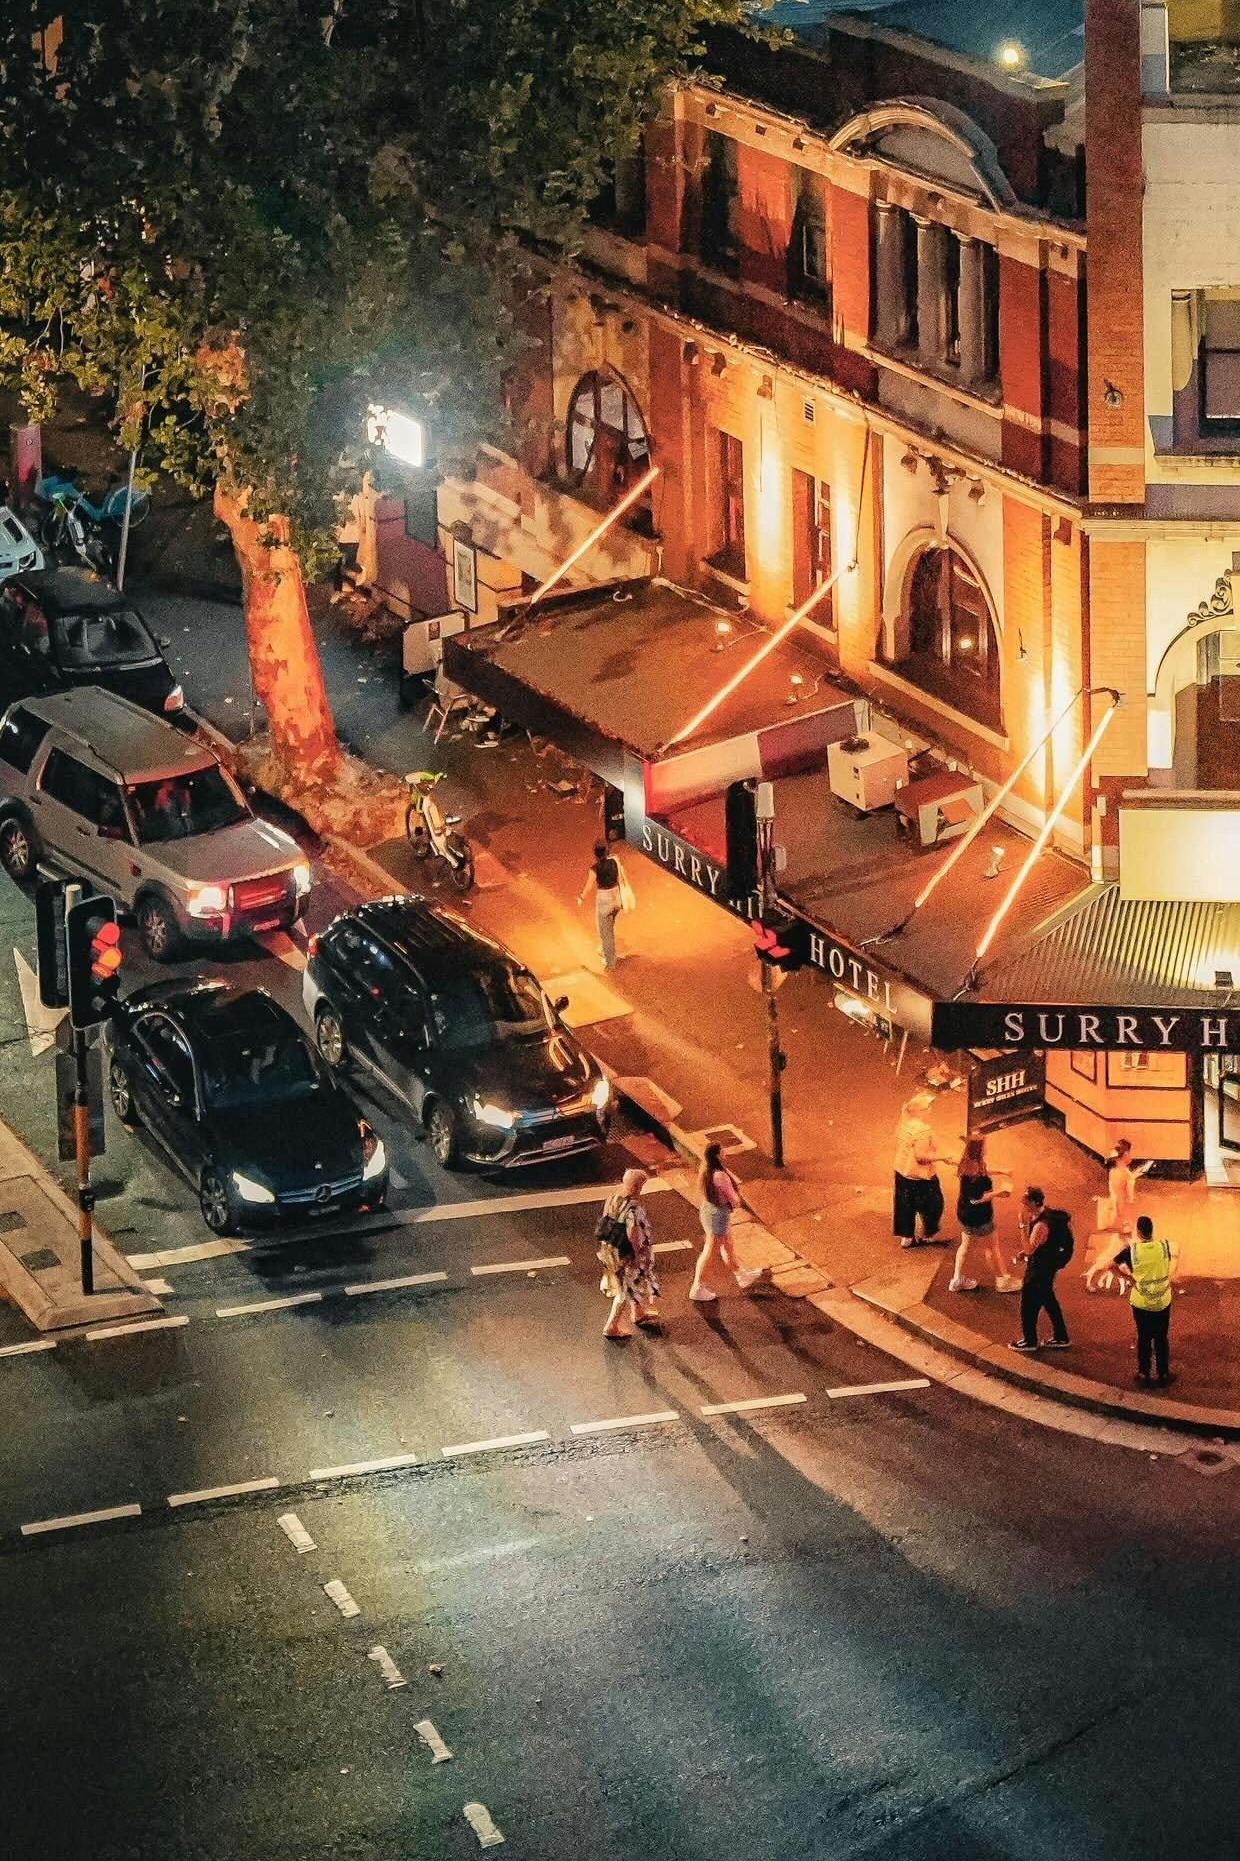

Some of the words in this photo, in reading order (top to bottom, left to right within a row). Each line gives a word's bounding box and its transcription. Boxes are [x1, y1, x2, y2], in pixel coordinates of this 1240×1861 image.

[642, 823, 721, 896] SURRY
[808, 932, 899, 1015] HOTEL
[1003, 1011, 1180, 1046] SURRY
[985, 1068, 1027, 1097] SHH
